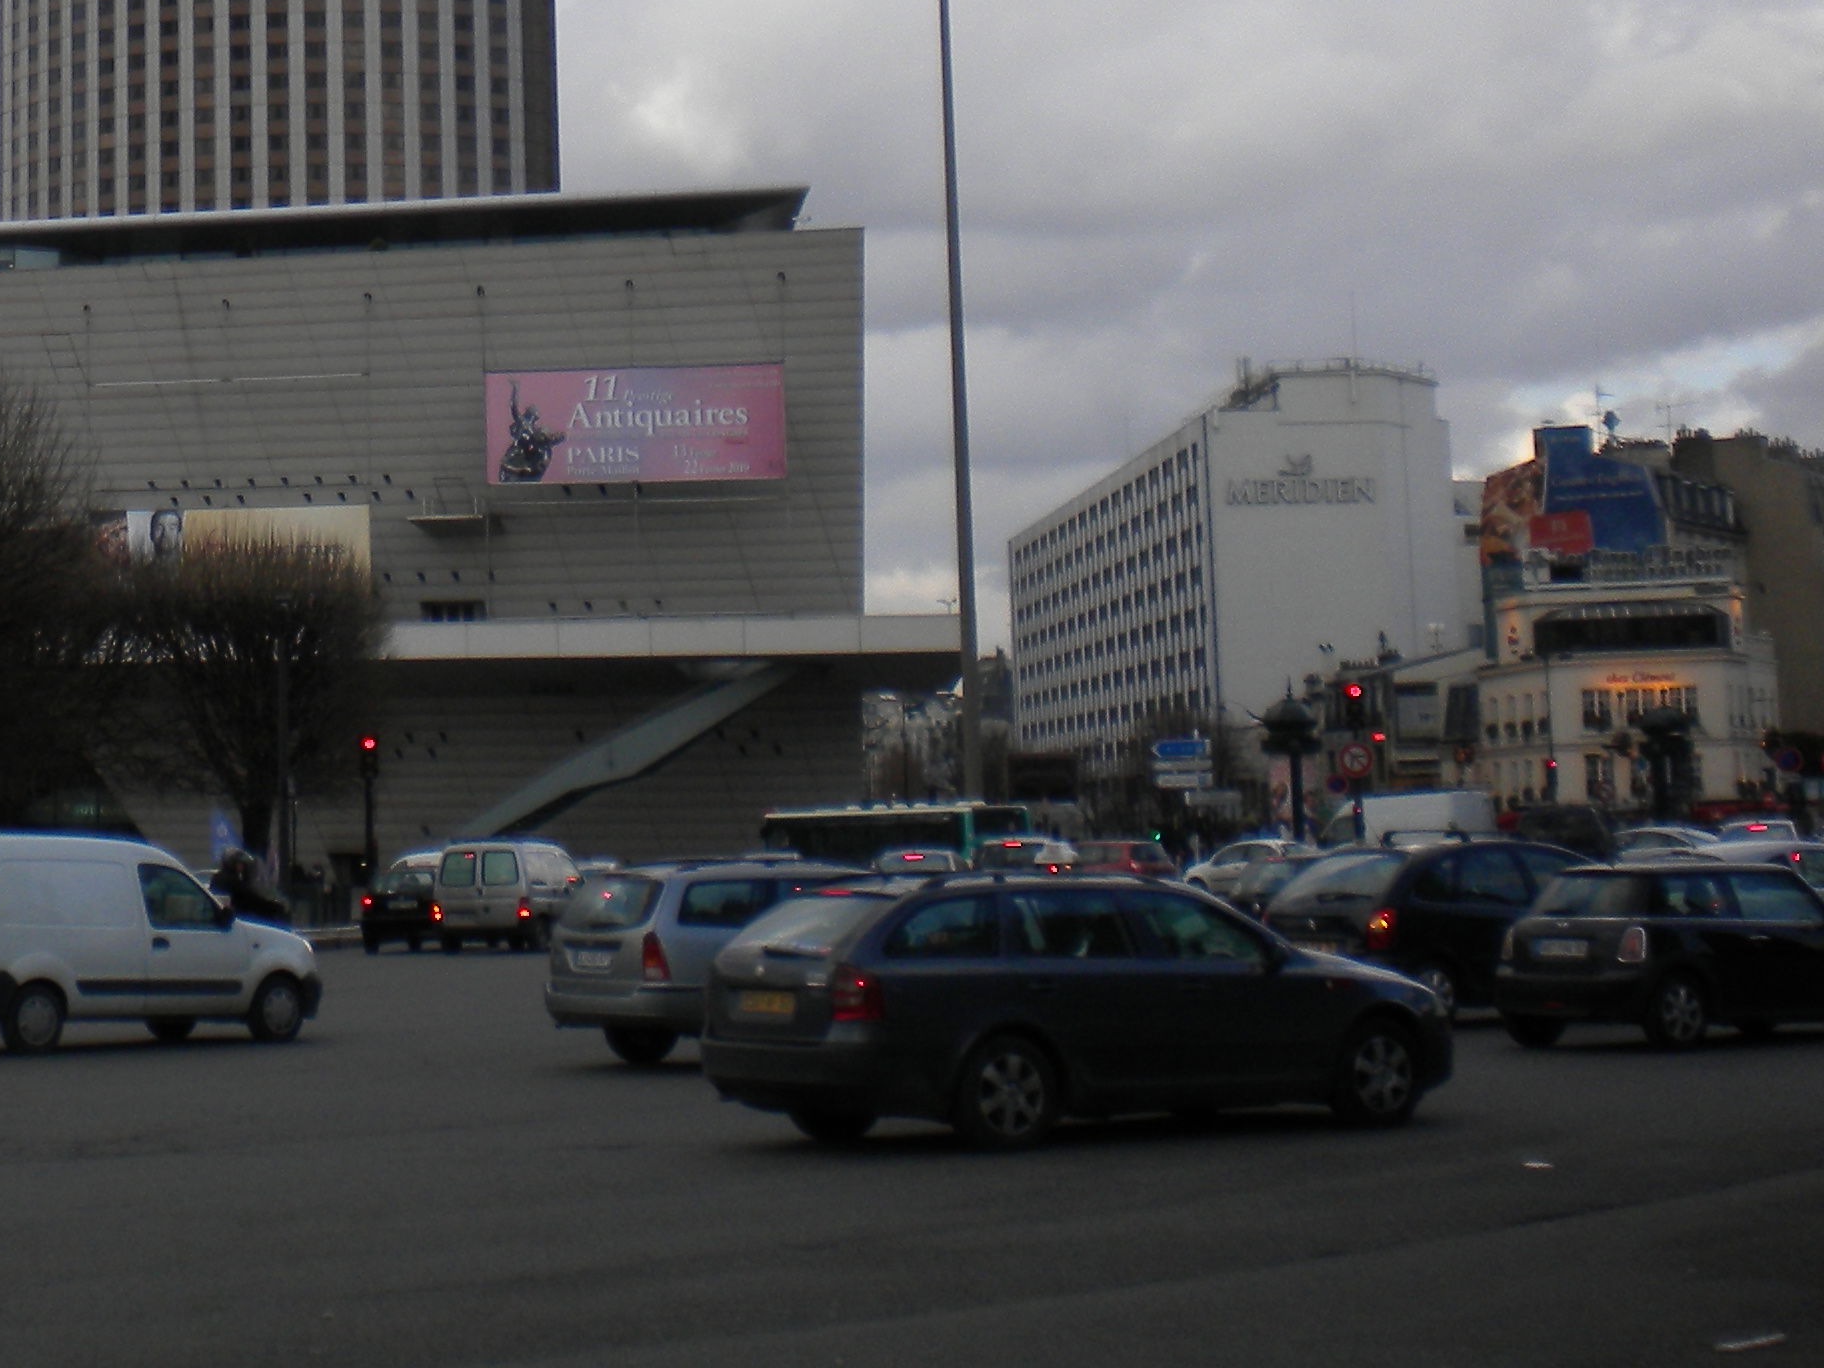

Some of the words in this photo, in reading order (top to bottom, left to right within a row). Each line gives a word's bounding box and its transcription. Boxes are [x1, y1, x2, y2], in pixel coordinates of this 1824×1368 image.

[584, 375, 617, 401] 11
[567, 399, 749, 436] Antiquaires
[567, 446, 640, 464] PARIS
[1225, 478, 1377, 506] MERIDIEN
